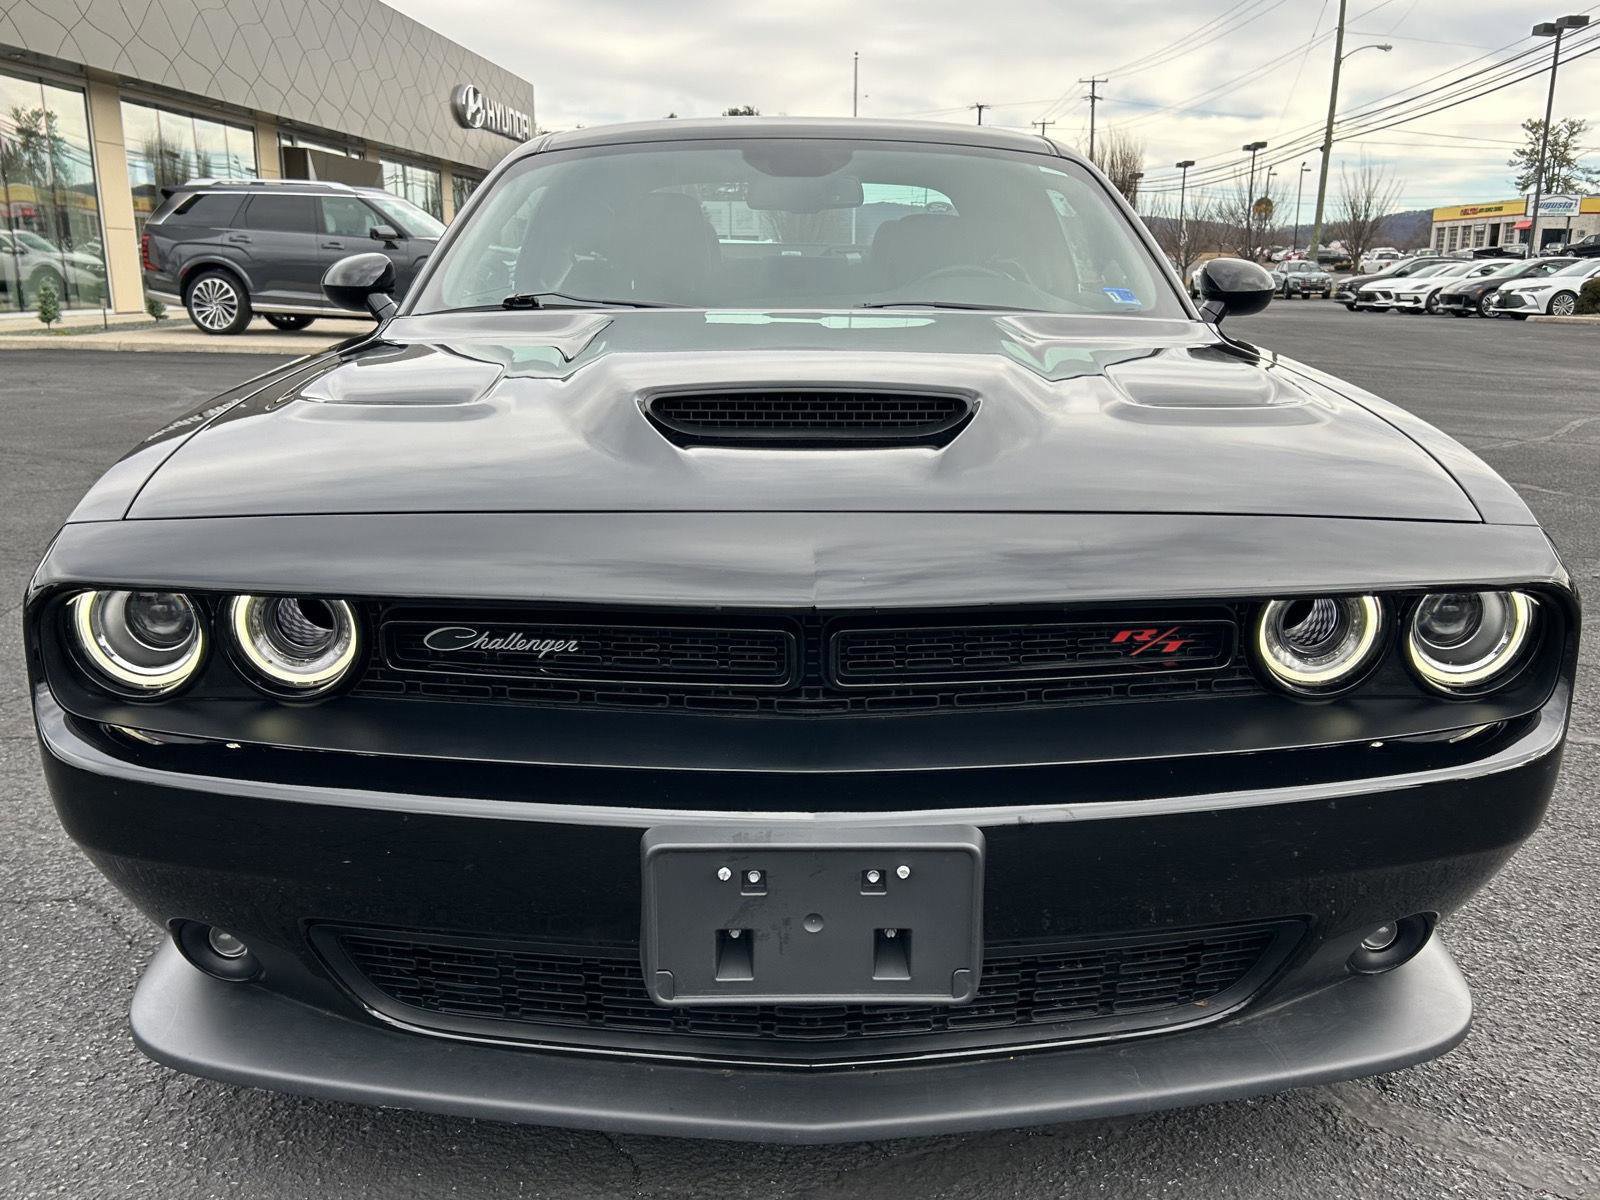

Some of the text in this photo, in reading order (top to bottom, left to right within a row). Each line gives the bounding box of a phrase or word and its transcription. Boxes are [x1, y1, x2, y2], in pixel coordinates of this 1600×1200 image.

[486, 97, 532, 142] HYUNDAI
[1532, 200, 1575, 210] ugusta
[423, 626, 579, 659] Challenger
[1111, 626, 1191, 656] R/T
